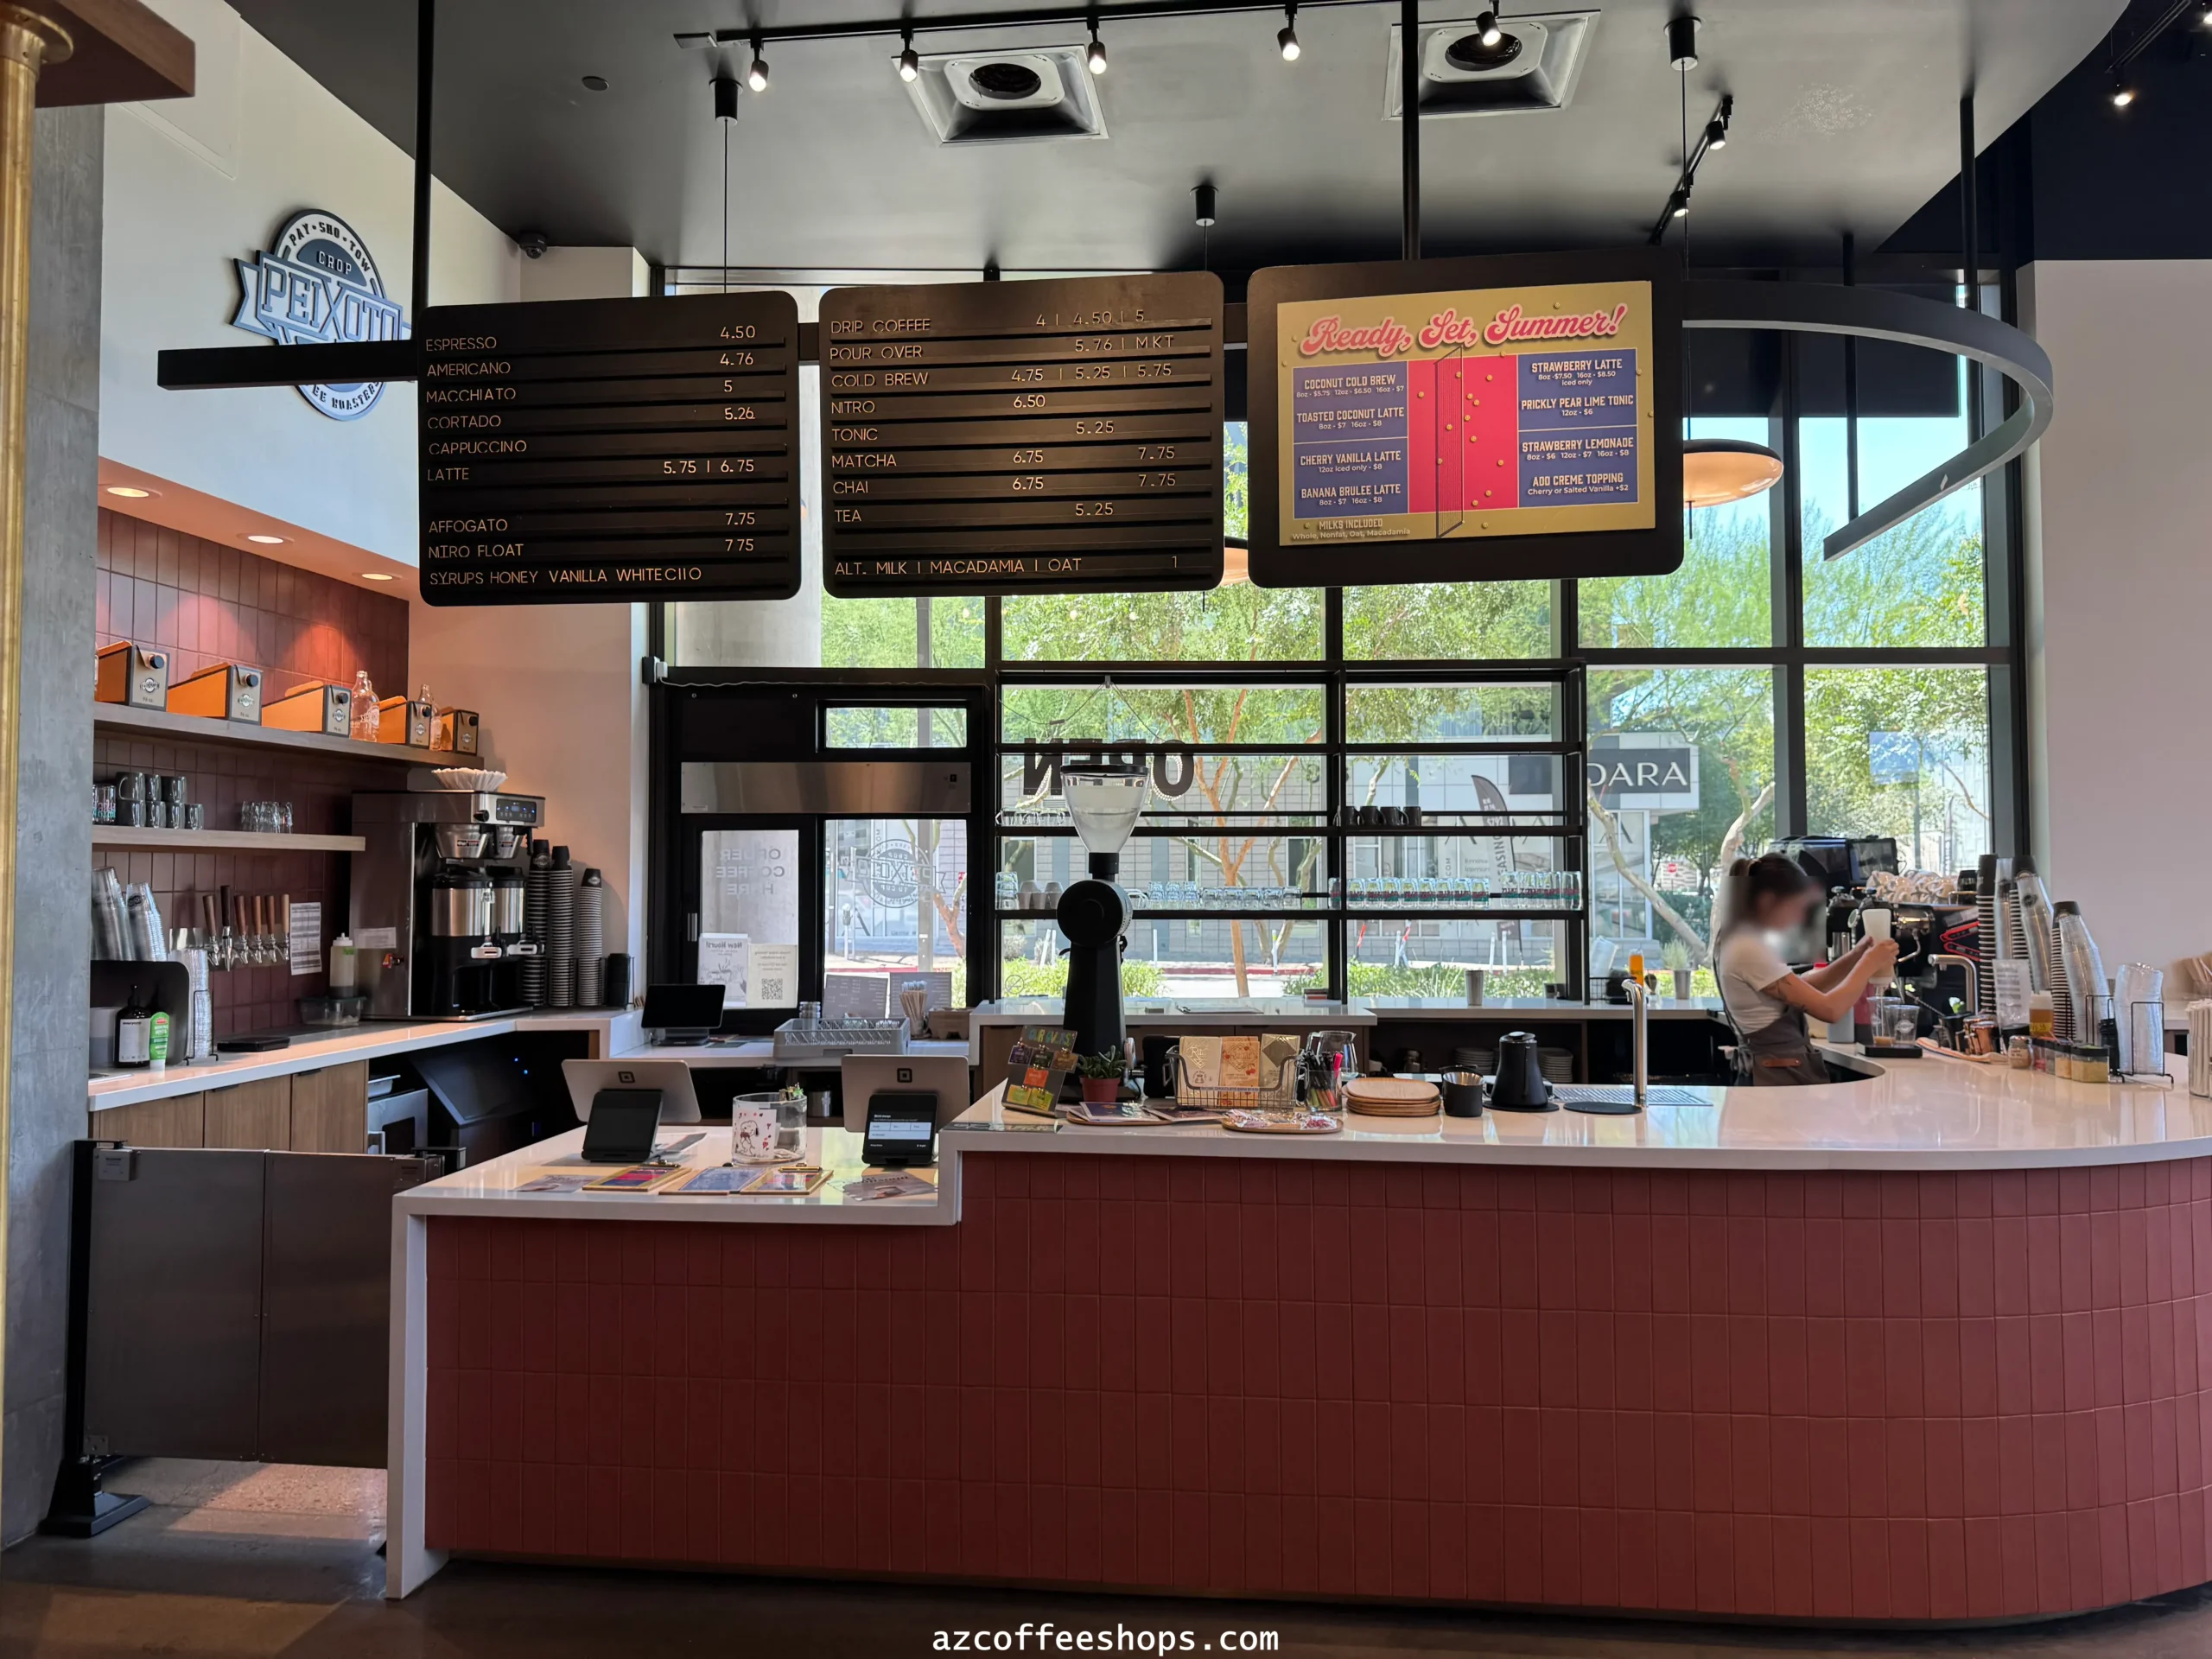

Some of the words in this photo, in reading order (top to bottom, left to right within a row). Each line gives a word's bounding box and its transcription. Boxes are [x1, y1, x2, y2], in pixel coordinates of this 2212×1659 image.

[289, 224, 309, 246] PAY
[319, 222, 340, 238] SHO
[349, 240, 371, 272] TOW
[319, 251, 352, 275] CROP
[831, 320, 864, 334] DRIP
[873, 318, 931, 333] COFFEE
[1036, 315, 1046, 327] 4
[1073, 310, 1113, 326] 4.50
[1135, 309, 1144, 321] 5
[1300, 315, 1413, 358] Ready,
[1419, 308, 1479, 349] Set,
[1484, 302, 1628, 346] Summer!
[426, 337, 497, 352] ESPRESSO
[721, 326, 756, 339] 4.50
[830, 346, 872, 360] POUR
[881, 345, 923, 359] OVER
[1075, 339, 1113, 352] 5.76
[1135, 335, 1175, 350] MKT
[427, 362, 511, 377] AMERICANO
[721, 353, 753, 365] 4.76
[1532, 360, 1592, 372] STRAWBERRY
[1595, 359, 1622, 370] LATTE
[832, 373, 875, 387] COLD
[885, 372, 929, 386] BREW
[1012, 369, 1044, 382] 4.75
[1075, 365, 1110, 379] 5.25
[1137, 364, 1173, 377] 5.75
[1305, 378, 1344, 390] COCONUT
[1346, 377, 1367, 387] COLD
[1370, 374, 1395, 385] BREW
[427, 388, 516, 403] MACCHIATO
[724, 380, 733, 392] 5
[831, 401, 875, 414] NITRO
[1014, 395, 1046, 409] 6.50
[1522, 398, 1557, 410] PRICKLY
[1560, 397, 1581, 408] PEAR
[1585, 396, 1605, 407] LIME
[1608, 395, 1633, 405] TONIC
[428, 416, 501, 429] CORTADO
[1297, 411, 1334, 423] TOASTED
[1337, 409, 1375, 420] COCONUT
[1378, 407, 1404, 417] LATTE
[832, 428, 878, 442] TONIC
[1076, 421, 1115, 435] 5.25
[429, 441, 527, 454] CAPPUCCINO
[1522, 440, 1582, 452] STRAWBERRY
[1586, 437, 1633, 448] LEMONADE
[832, 454, 897, 468] MATCHA
[1013, 450, 1044, 464] 6.75
[1138, 447, 1175, 460] 7.75
[1300, 454, 1332, 466] CHERRY
[1336, 452, 1372, 463] VANILLA
[1375, 450, 1401, 461] LATTE
[428, 468, 469, 481] LATTE
[664, 461, 696, 474] 5.75
[721, 460, 754, 473] 6.75
[1533, 476, 1550, 486] ADD
[1554, 474, 1583, 485] CREME
[1586, 473, 1624, 484] TOPPING
[833, 480, 868, 494] CHAI
[1013, 477, 1044, 490] 6.75
[1139, 474, 1176, 486] 7.75
[1301, 487, 1336, 499] BANANA
[1339, 486, 1371, 496] BRULEE
[1374, 484, 1401, 494] LATTE
[835, 509, 861, 522] TEA
[1076, 503, 1114, 517] 5.25
[429, 519, 508, 533] AFFOGATO
[725, 513, 755, 525] 7.75
[1319, 520, 1343, 530] MILKS
[1346, 518, 1382, 528] INCLUDED
[478, 543, 524, 557] FLOAT
[835, 562, 867, 575] ALT.
[876, 561, 907, 575] MILK
[931, 559, 1025, 574] MACADAMIA
[1048, 557, 1082, 571] OAT
[430, 572, 484, 585] SYRUPS
[490, 571, 537, 584] HONEY
[549, 569, 607, 582] VANILLA
